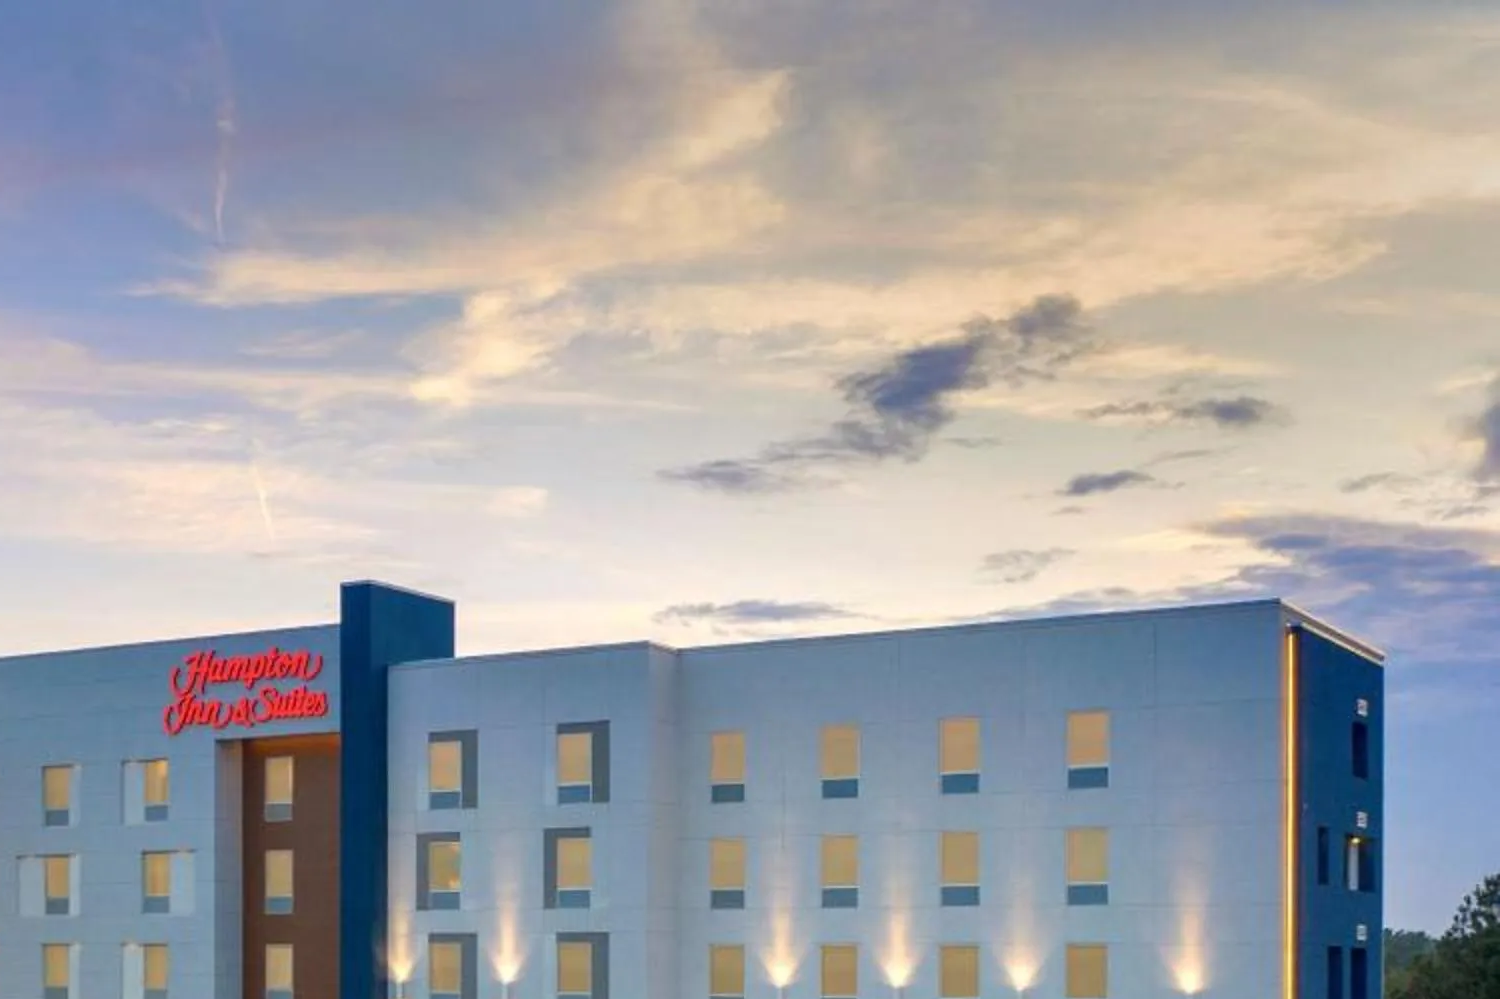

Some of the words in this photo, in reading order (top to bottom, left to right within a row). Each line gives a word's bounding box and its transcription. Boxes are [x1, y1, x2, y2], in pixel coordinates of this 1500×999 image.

[170, 647, 323, 697] Hampton
[163, 696, 232, 735] Inn
[231, 697, 255, 728] &
[253, 686, 328, 723] Suites
